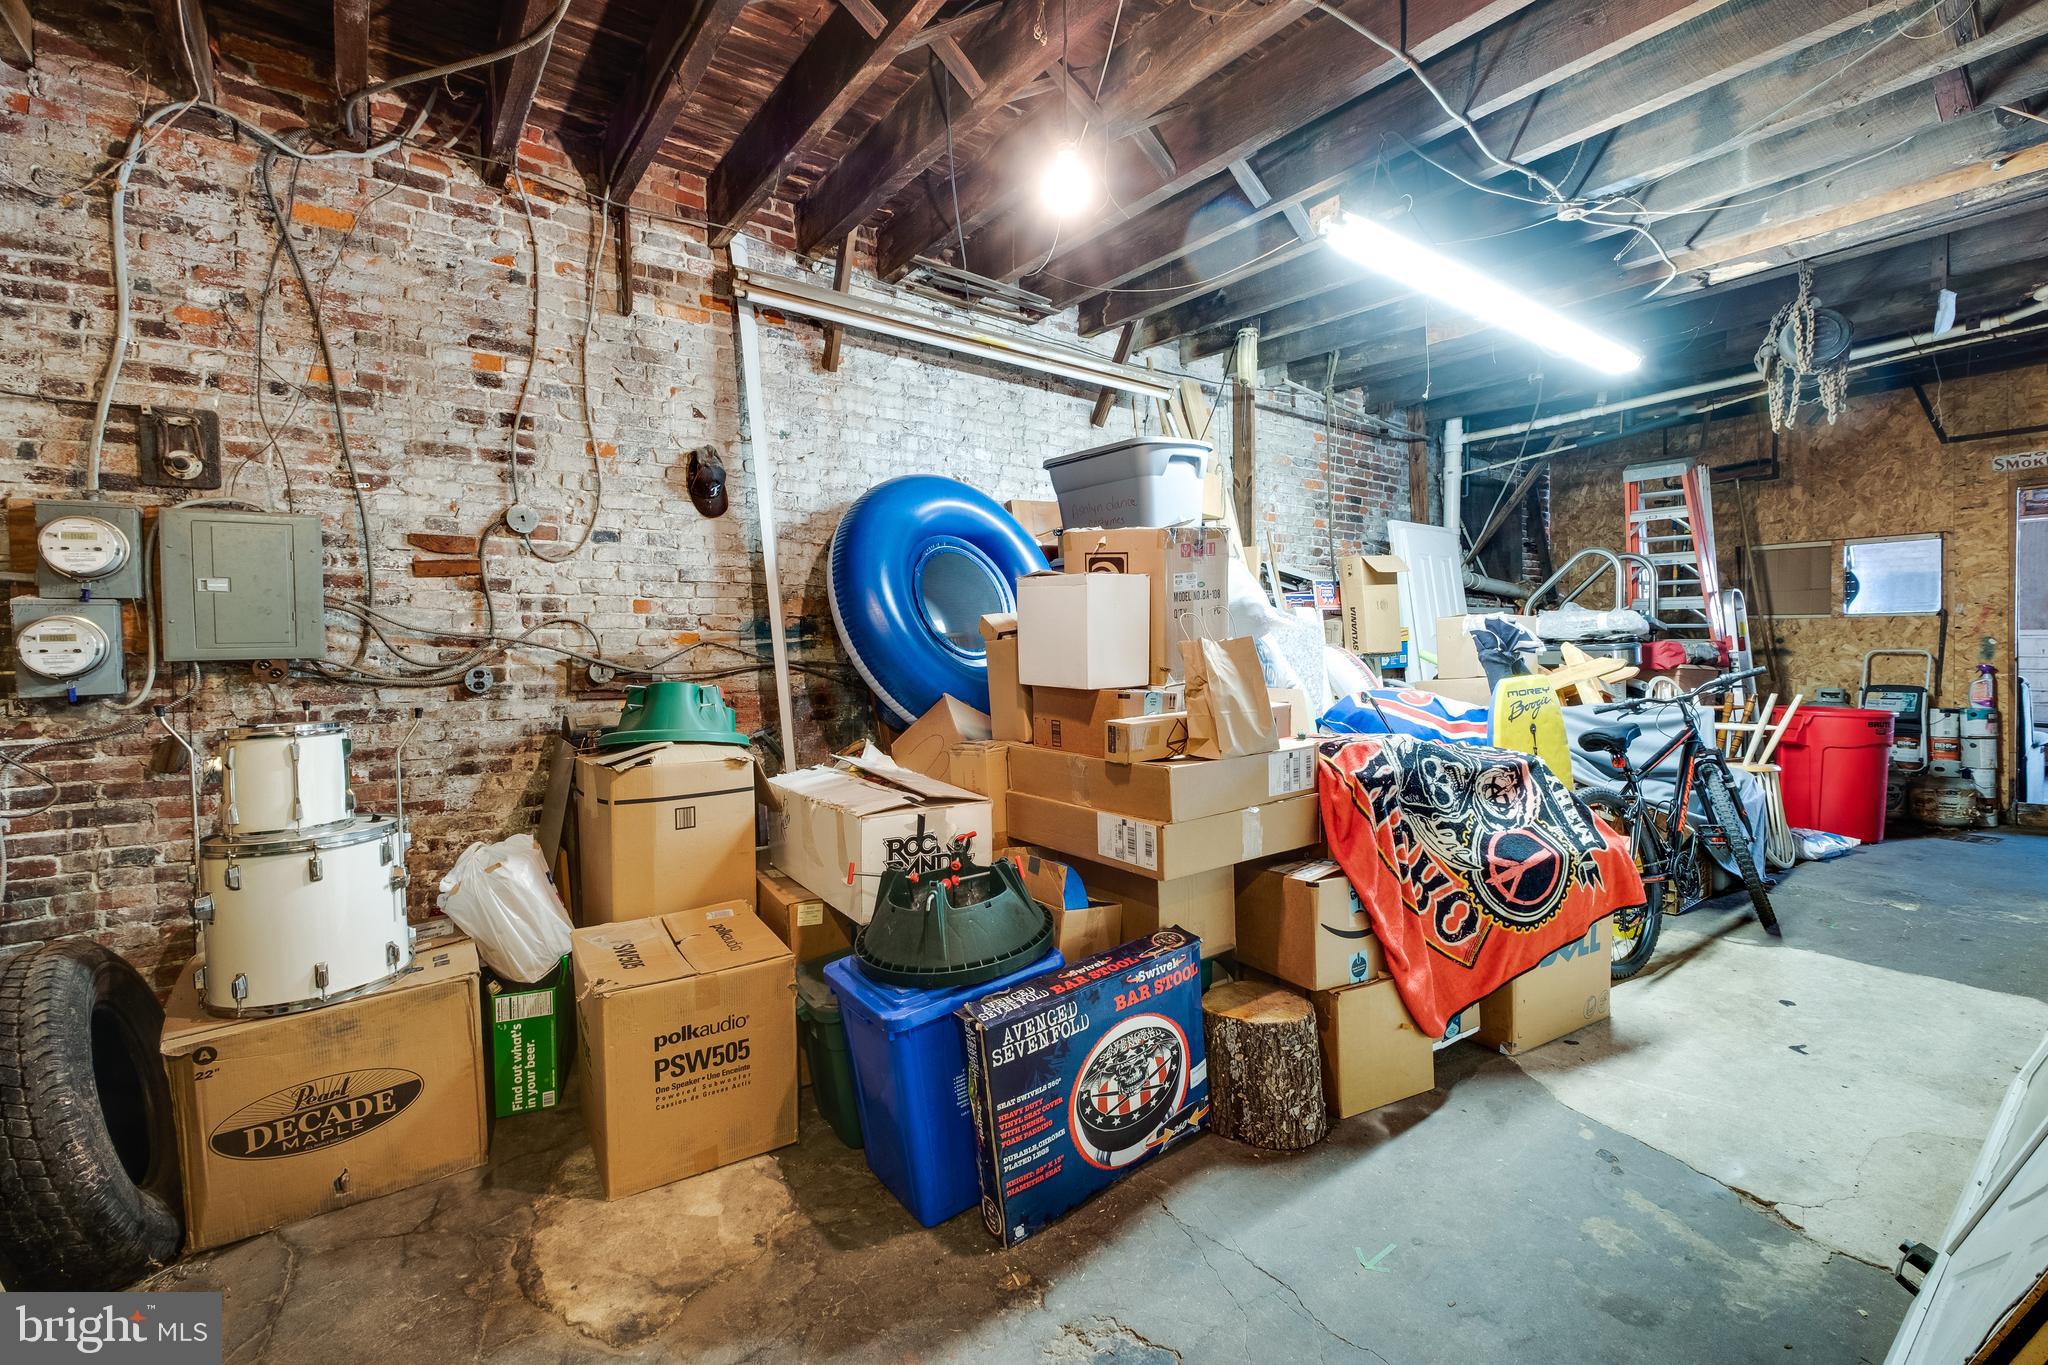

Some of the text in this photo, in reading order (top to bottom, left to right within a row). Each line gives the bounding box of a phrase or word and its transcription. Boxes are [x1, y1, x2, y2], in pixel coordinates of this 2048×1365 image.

[1173, 591, 1192, 602] MODEL
[1350, 607, 1360, 651] SYLVANIA
[1507, 687, 1550, 698] MOREY
[1508, 698, 1552, 723] Boogie
[708, 923, 744, 952] polkaudio
[1050, 957, 1140, 996] BAR STOOL
[1068, 959, 1109, 978] Swivel
[1137, 955, 1182, 984] Swivel
[981, 987, 1036, 1013] AVENGED
[1114, 963, 1199, 1012] BAR STOOL
[1002, 1001, 1078, 1046] AVENGED
[198, 1050, 212, 1061] A
[511, 1023, 523, 1112] Find out what's
[654, 1038, 751, 1083] PSW505
[194, 1068, 220, 1081] 22"
[524, 1039, 539, 1109] in your beer.
[655, 1064, 751, 1095] One Speaker Une Enceinte
[281, 1075, 350, 1115] Pearl
[655, 1088, 697, 1103] Powered
[690, 1093, 699, 1101] de
[702, 1086, 729, 1098] Graves
[996, 1098, 1016, 1111] SEAT
[1016, 1084, 1047, 1104] SWIVELS
[243, 1089, 397, 1155] DECADE
[998, 1098, 1043, 1122] HEAVY DUTY
[999, 1097, 1063, 1130] VINYL SEAT COVER
[282, 1119, 364, 1152] MAPLE
[1000, 1126, 1022, 1139] WITH
[1001, 1120, 1053, 1148] FOAM PADDING
[1003, 1146, 1050, 1173] PLATED LEGS
[1007, 1165, 1062, 1198] DIAMETER SEAT
